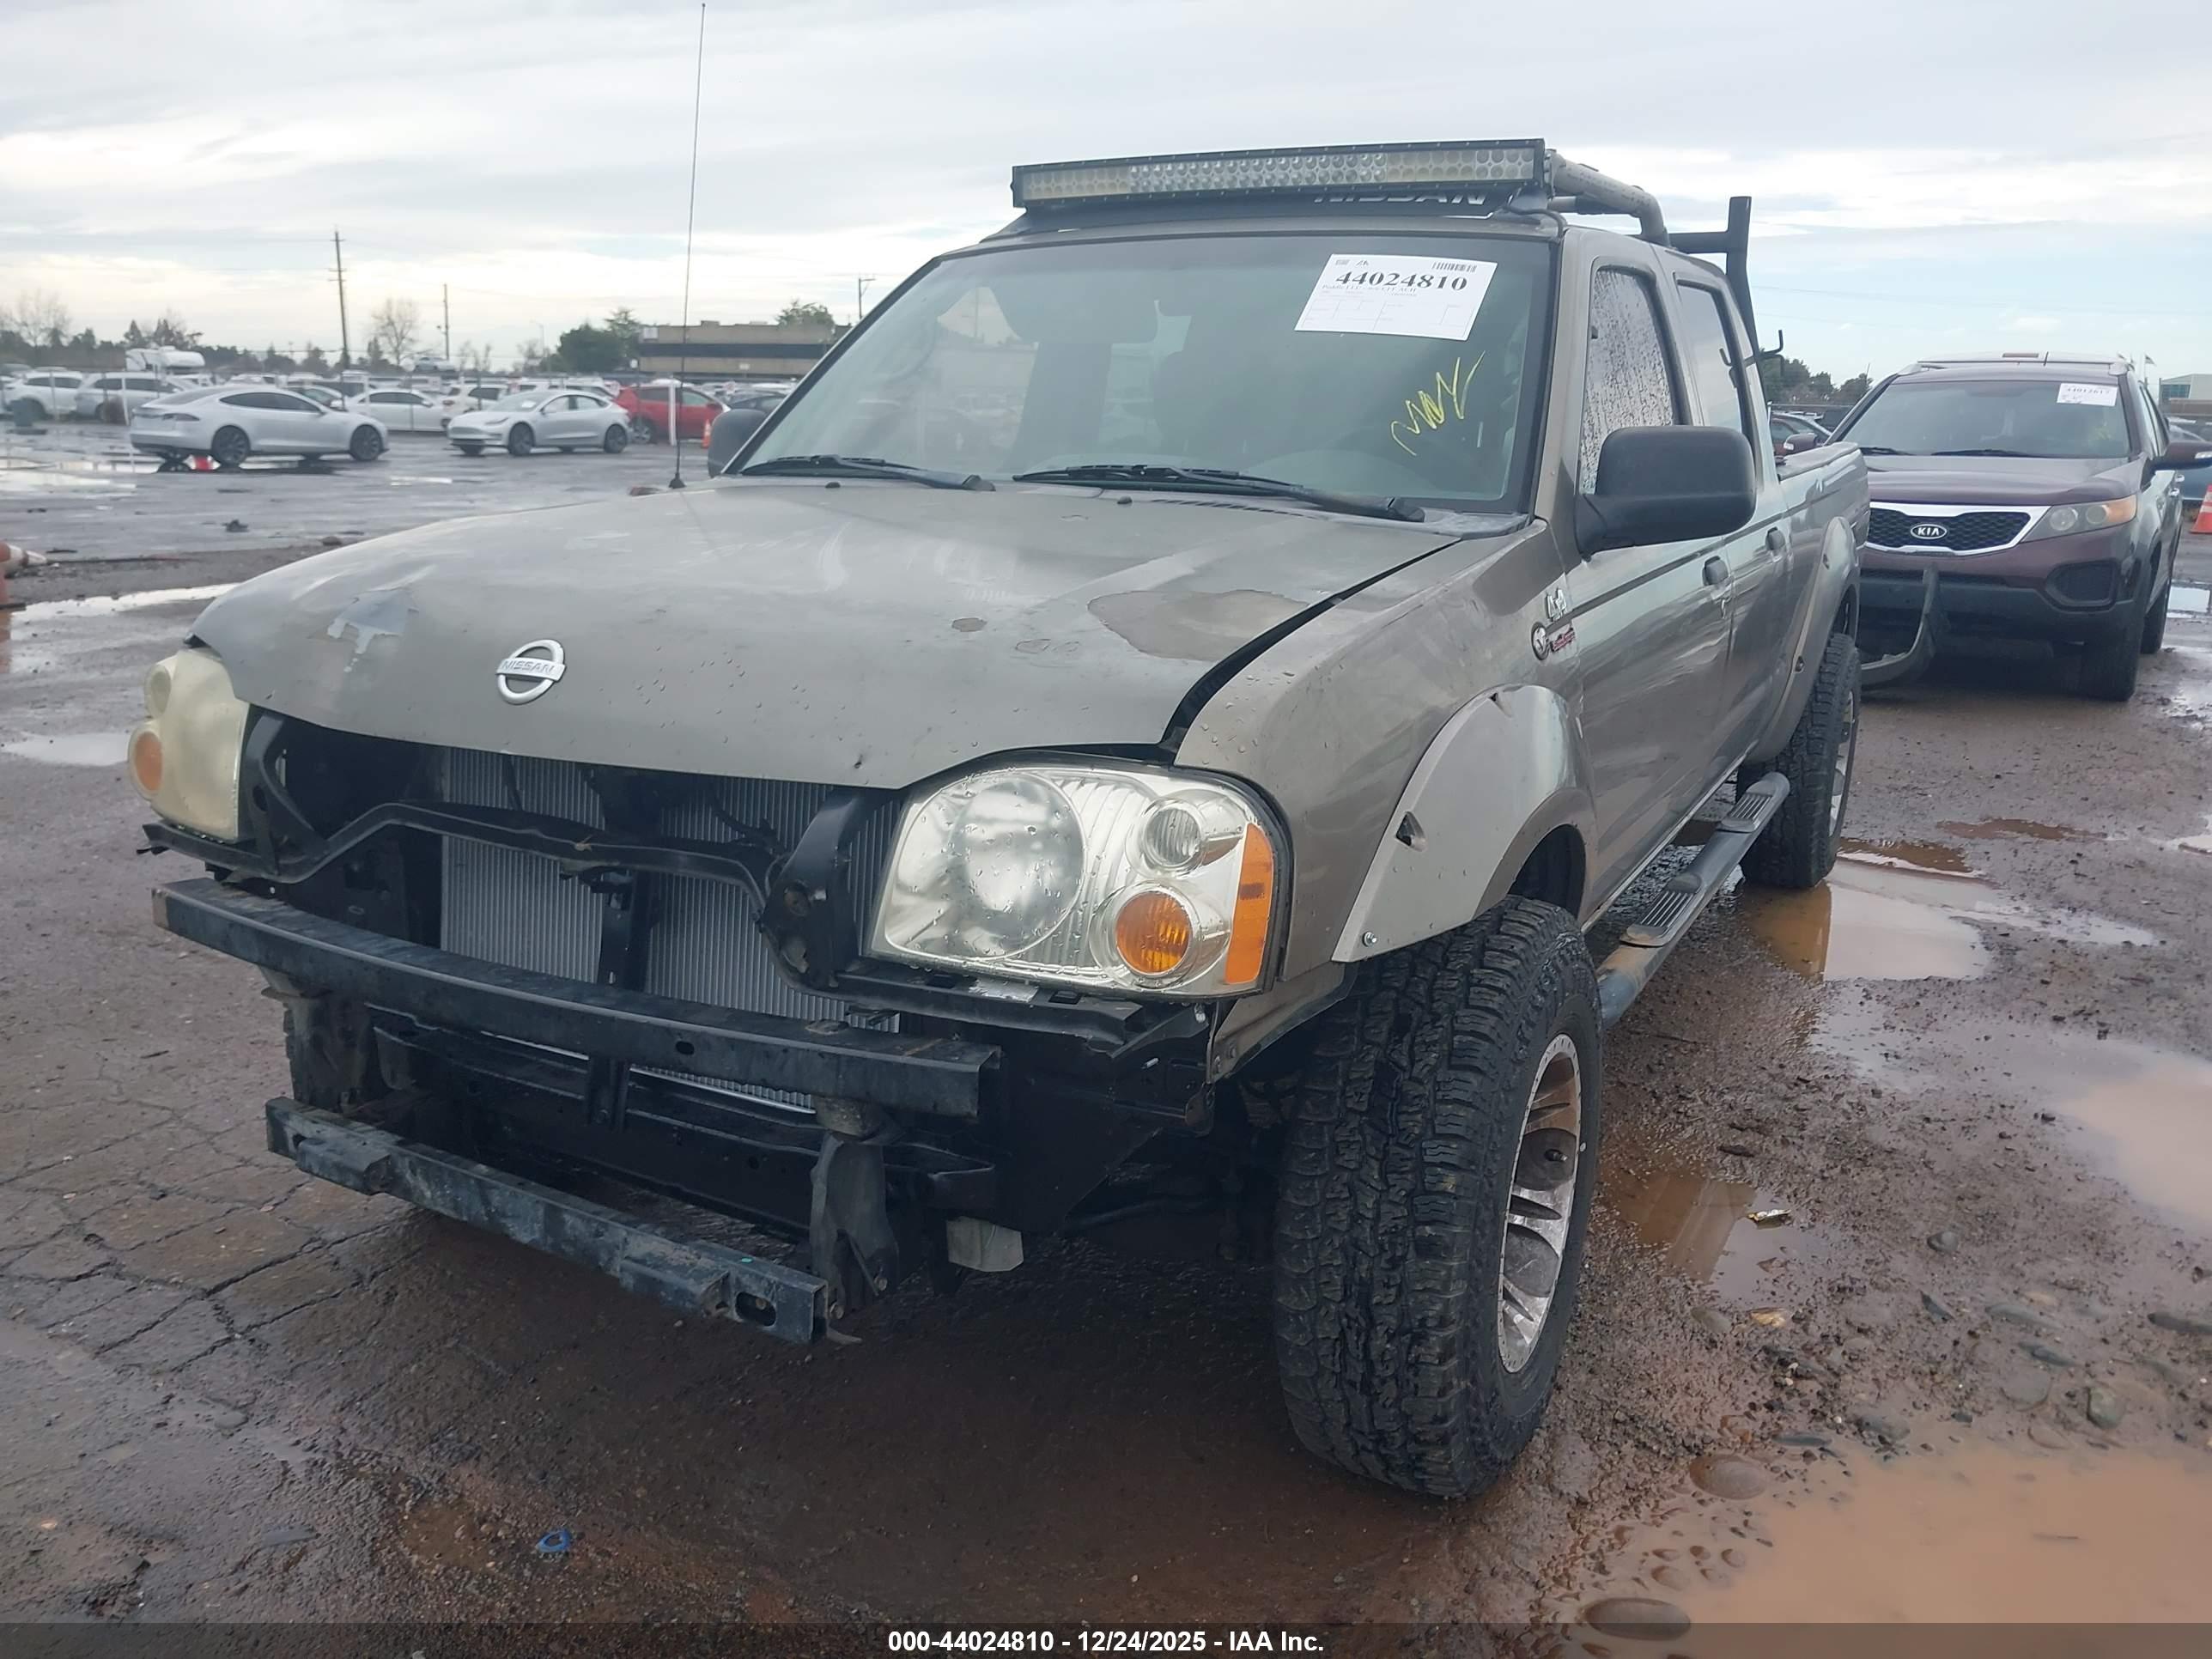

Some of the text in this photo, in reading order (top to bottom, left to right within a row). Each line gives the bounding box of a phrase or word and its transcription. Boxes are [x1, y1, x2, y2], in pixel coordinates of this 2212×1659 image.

[1336, 271, 1468, 291] 44024810
[1917, 526, 1940, 536] KIA
[502, 659, 555, 673] NISSAN
